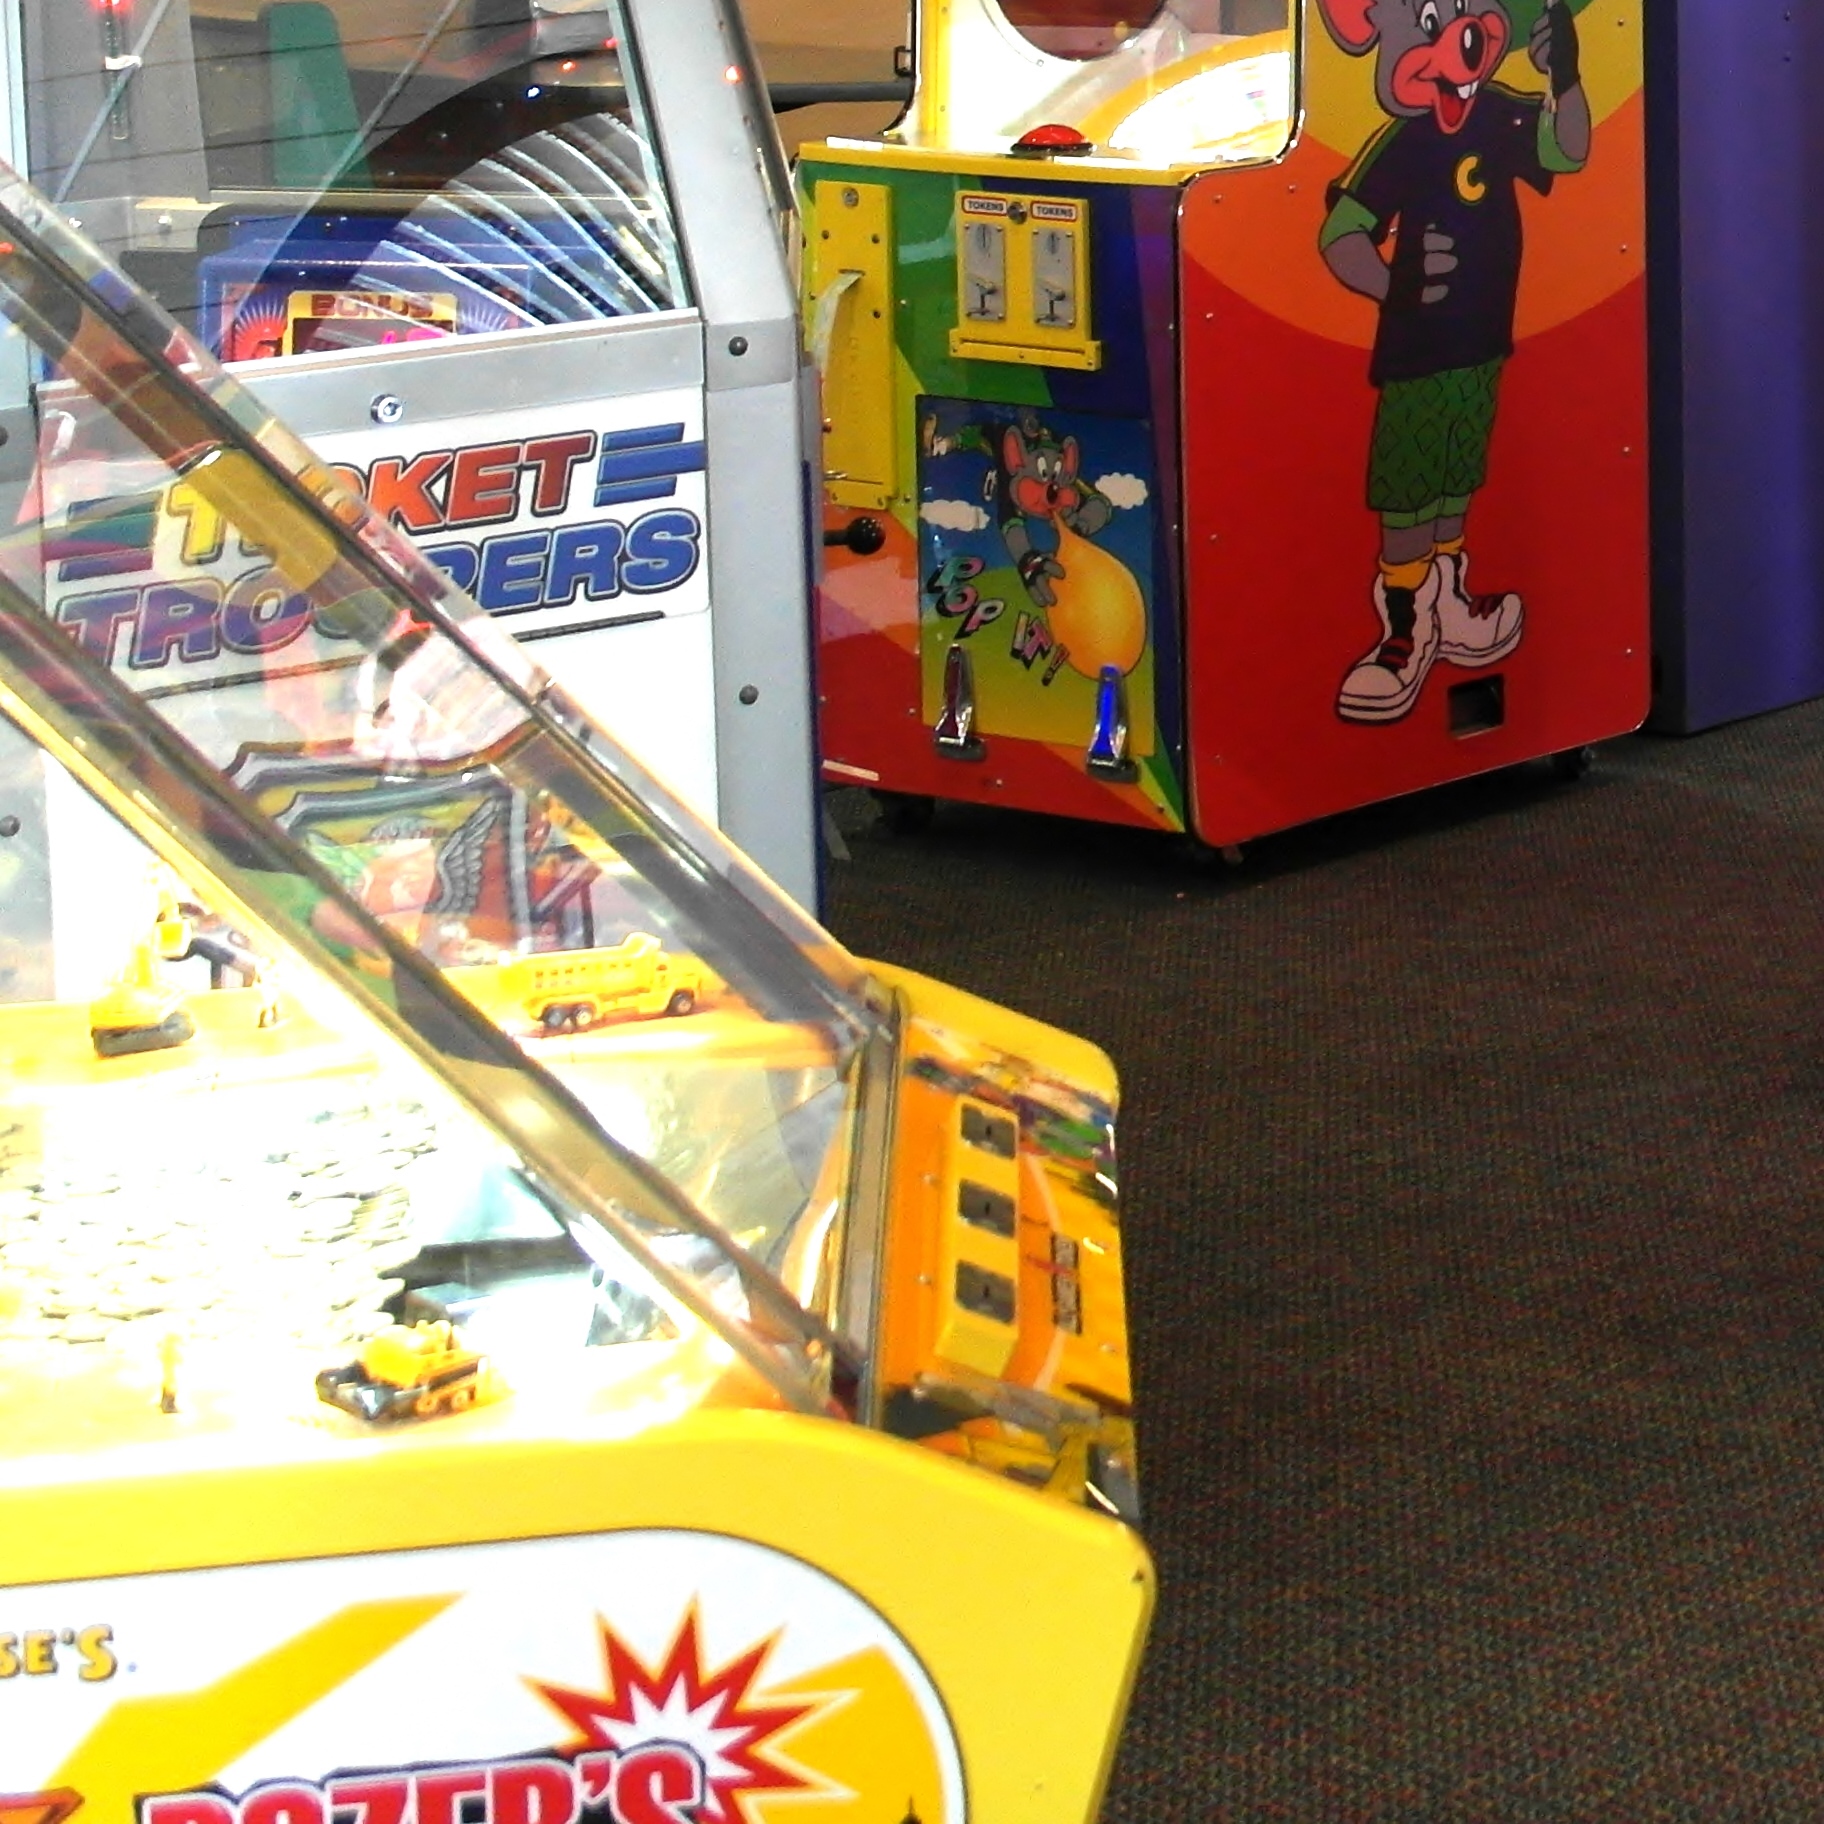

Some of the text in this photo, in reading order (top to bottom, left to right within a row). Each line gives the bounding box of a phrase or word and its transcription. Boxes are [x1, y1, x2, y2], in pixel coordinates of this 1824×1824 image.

[968, 200, 1004, 212] TOKENS
[1037, 205, 1073, 218] TOKENS
[311, 293, 434, 319] BONUS
[927, 555, 1005, 639] POP
